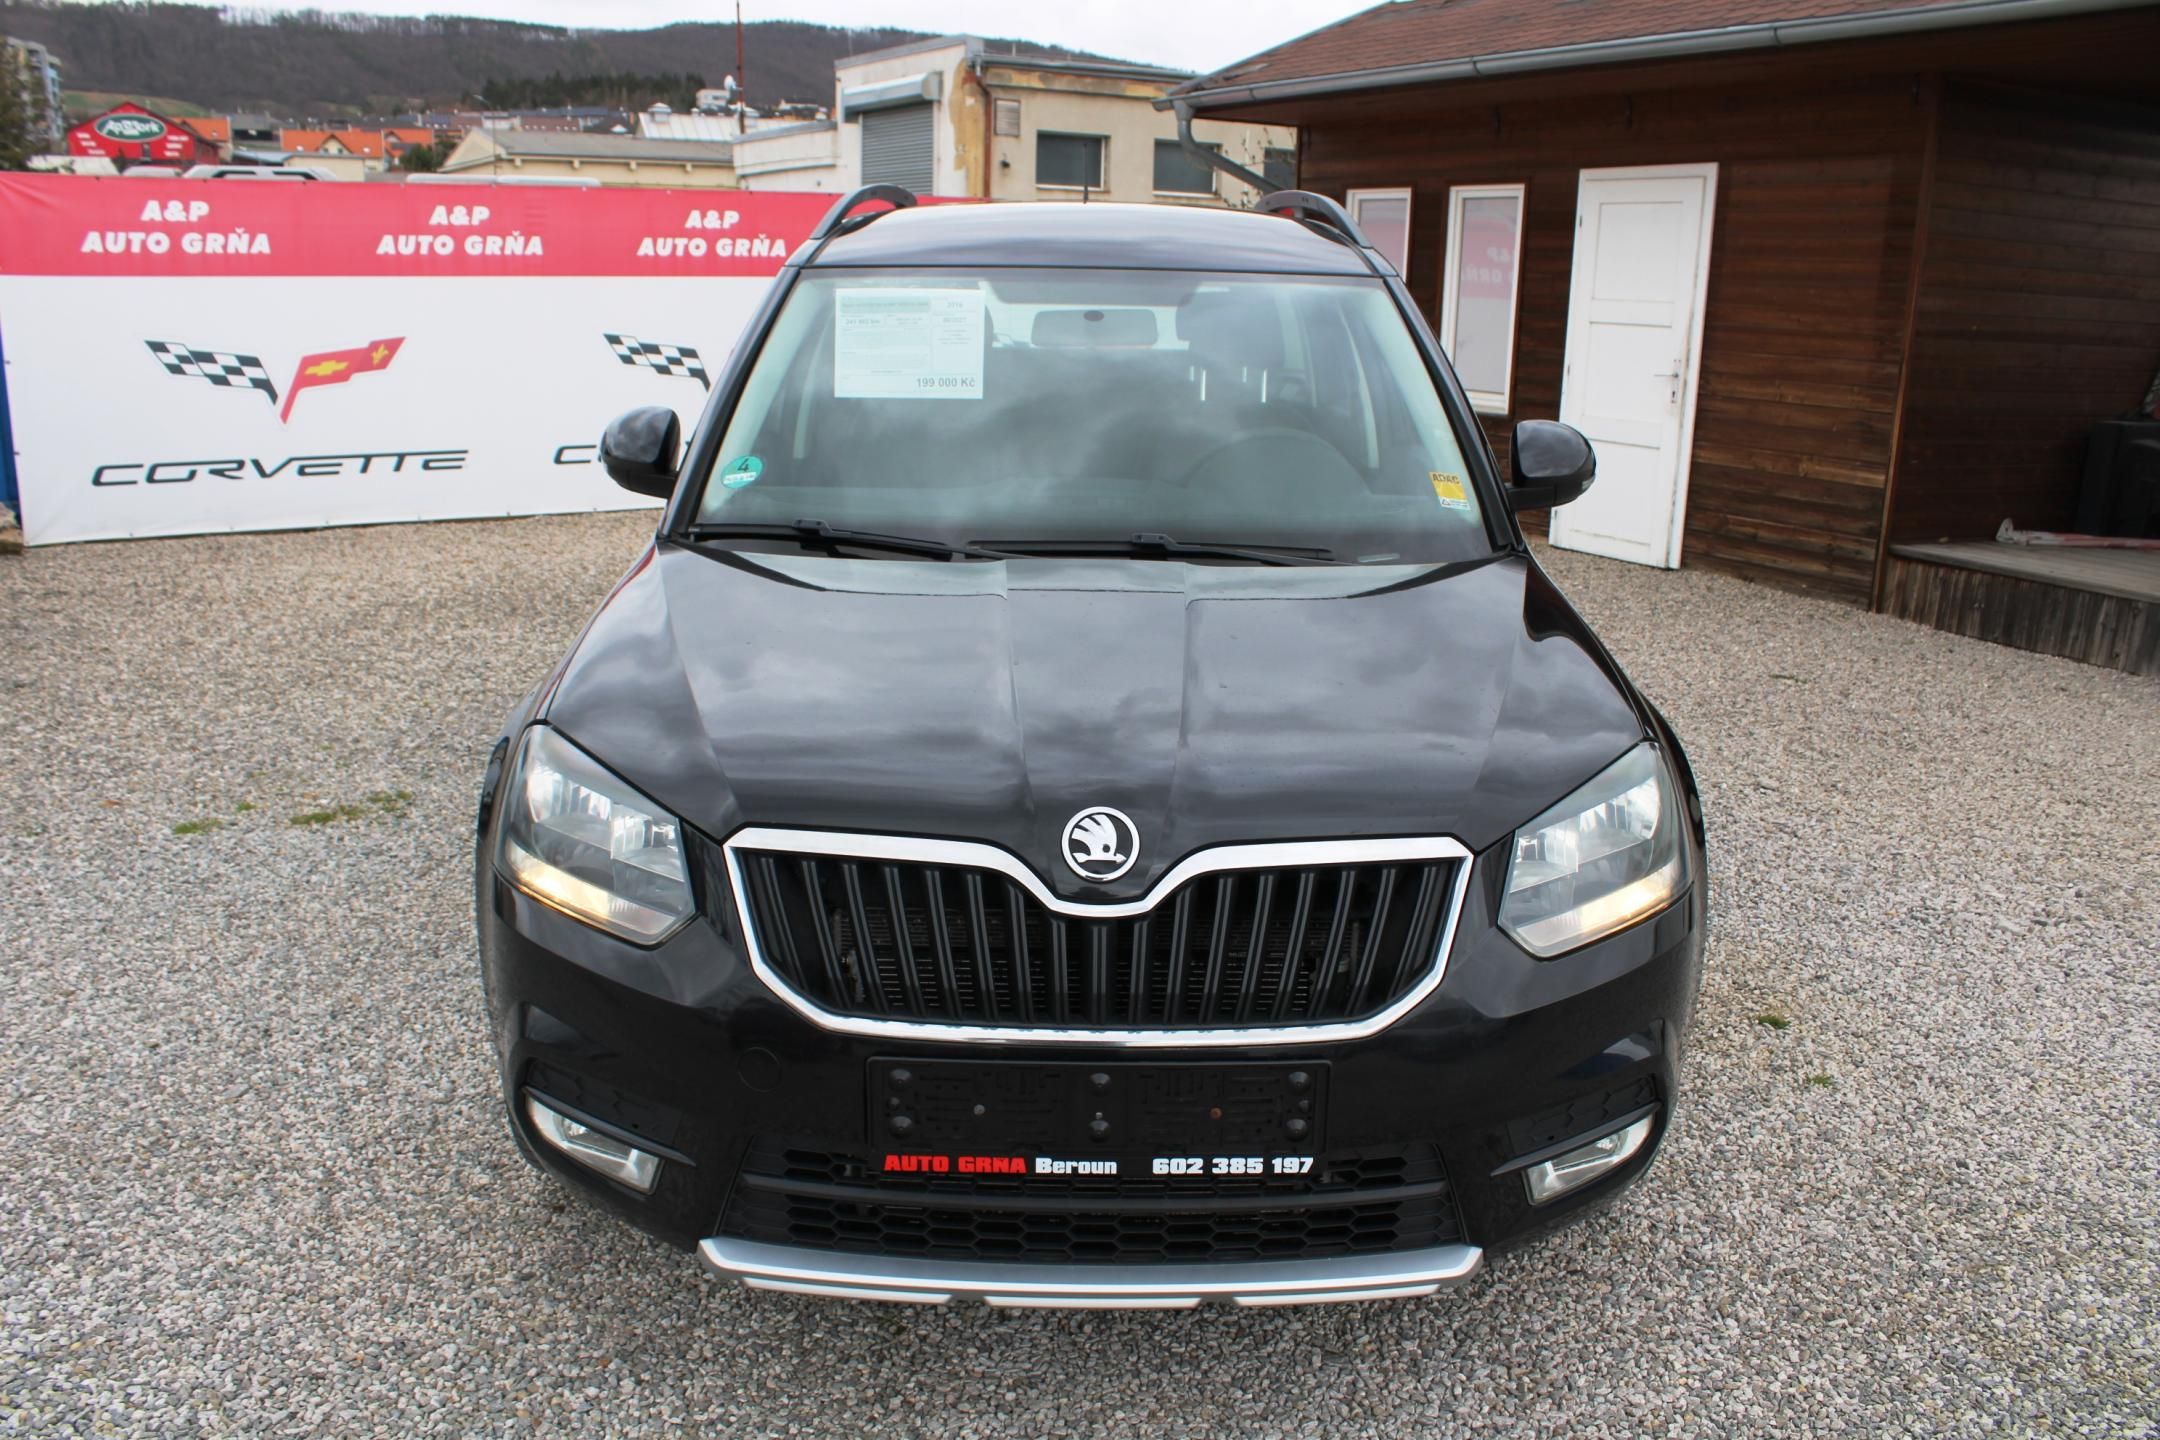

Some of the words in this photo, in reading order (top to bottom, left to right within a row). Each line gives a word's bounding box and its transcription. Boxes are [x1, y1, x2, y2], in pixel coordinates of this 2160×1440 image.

[140, 201, 209, 222] A&P
[429, 206, 490, 226] A&P
[685, 210, 740, 229] A&P
[81, 233, 170, 254] AUTO
[181, 228, 271, 255] GRŇA
[376, 235, 454, 256] AUTO
[464, 231, 544, 256] GRŇA
[637, 237, 708, 257] AUTO
[716, 234, 787, 258] GRŇA
[916, 377, 935, 388] 199
[939, 377, 958, 388] 000
[961, 377, 976, 388] Kč
[92, 449, 469, 487] CORVETTE
[737, 457, 749, 472] 4
[1432, 473, 1460, 484] ADAC
[884, 1154, 949, 1172] AUTO
[1035, 1157, 1118, 1175] Beroun
[1152, 1157, 1204, 1175] 602
[1212, 1157, 1264, 1174] 385
[1271, 1157, 1315, 1174] 197
